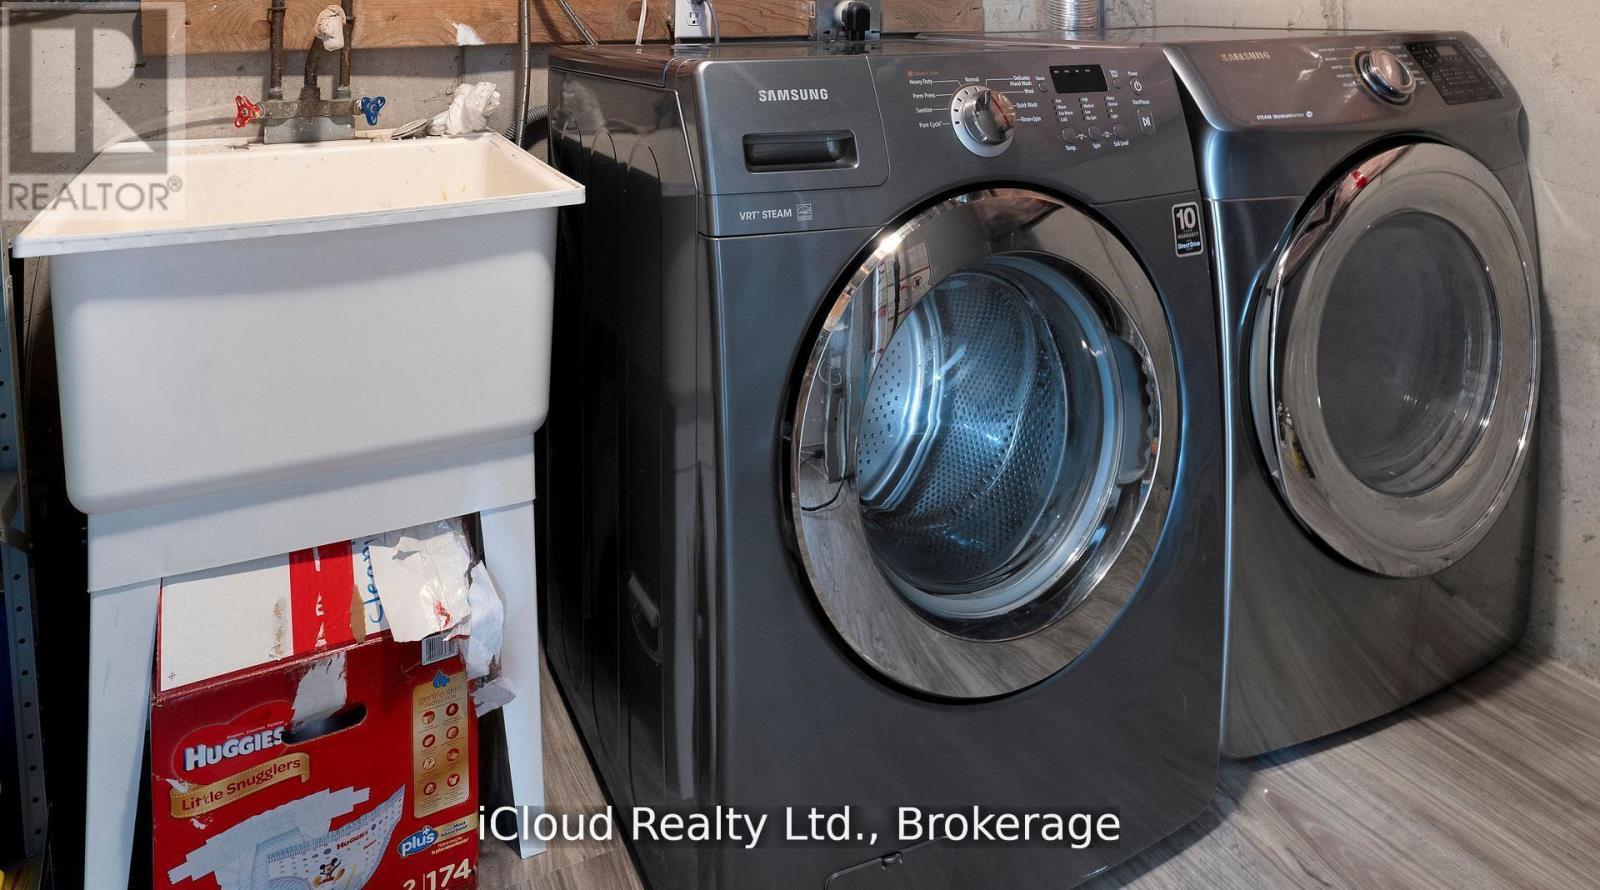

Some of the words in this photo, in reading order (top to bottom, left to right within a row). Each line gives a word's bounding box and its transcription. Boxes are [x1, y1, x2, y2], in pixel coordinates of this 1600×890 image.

[1221, 51, 1271, 62] SAMSUNG
[758, 88, 829, 102] SAMSUNG
[761, 208, 792, 220] STEAM
[1176, 207, 1196, 230] 10
[184, 726, 285, 771] HUGGIES
[226, 758, 301, 796] Snugglers
[426, 858, 472, 890] 174
